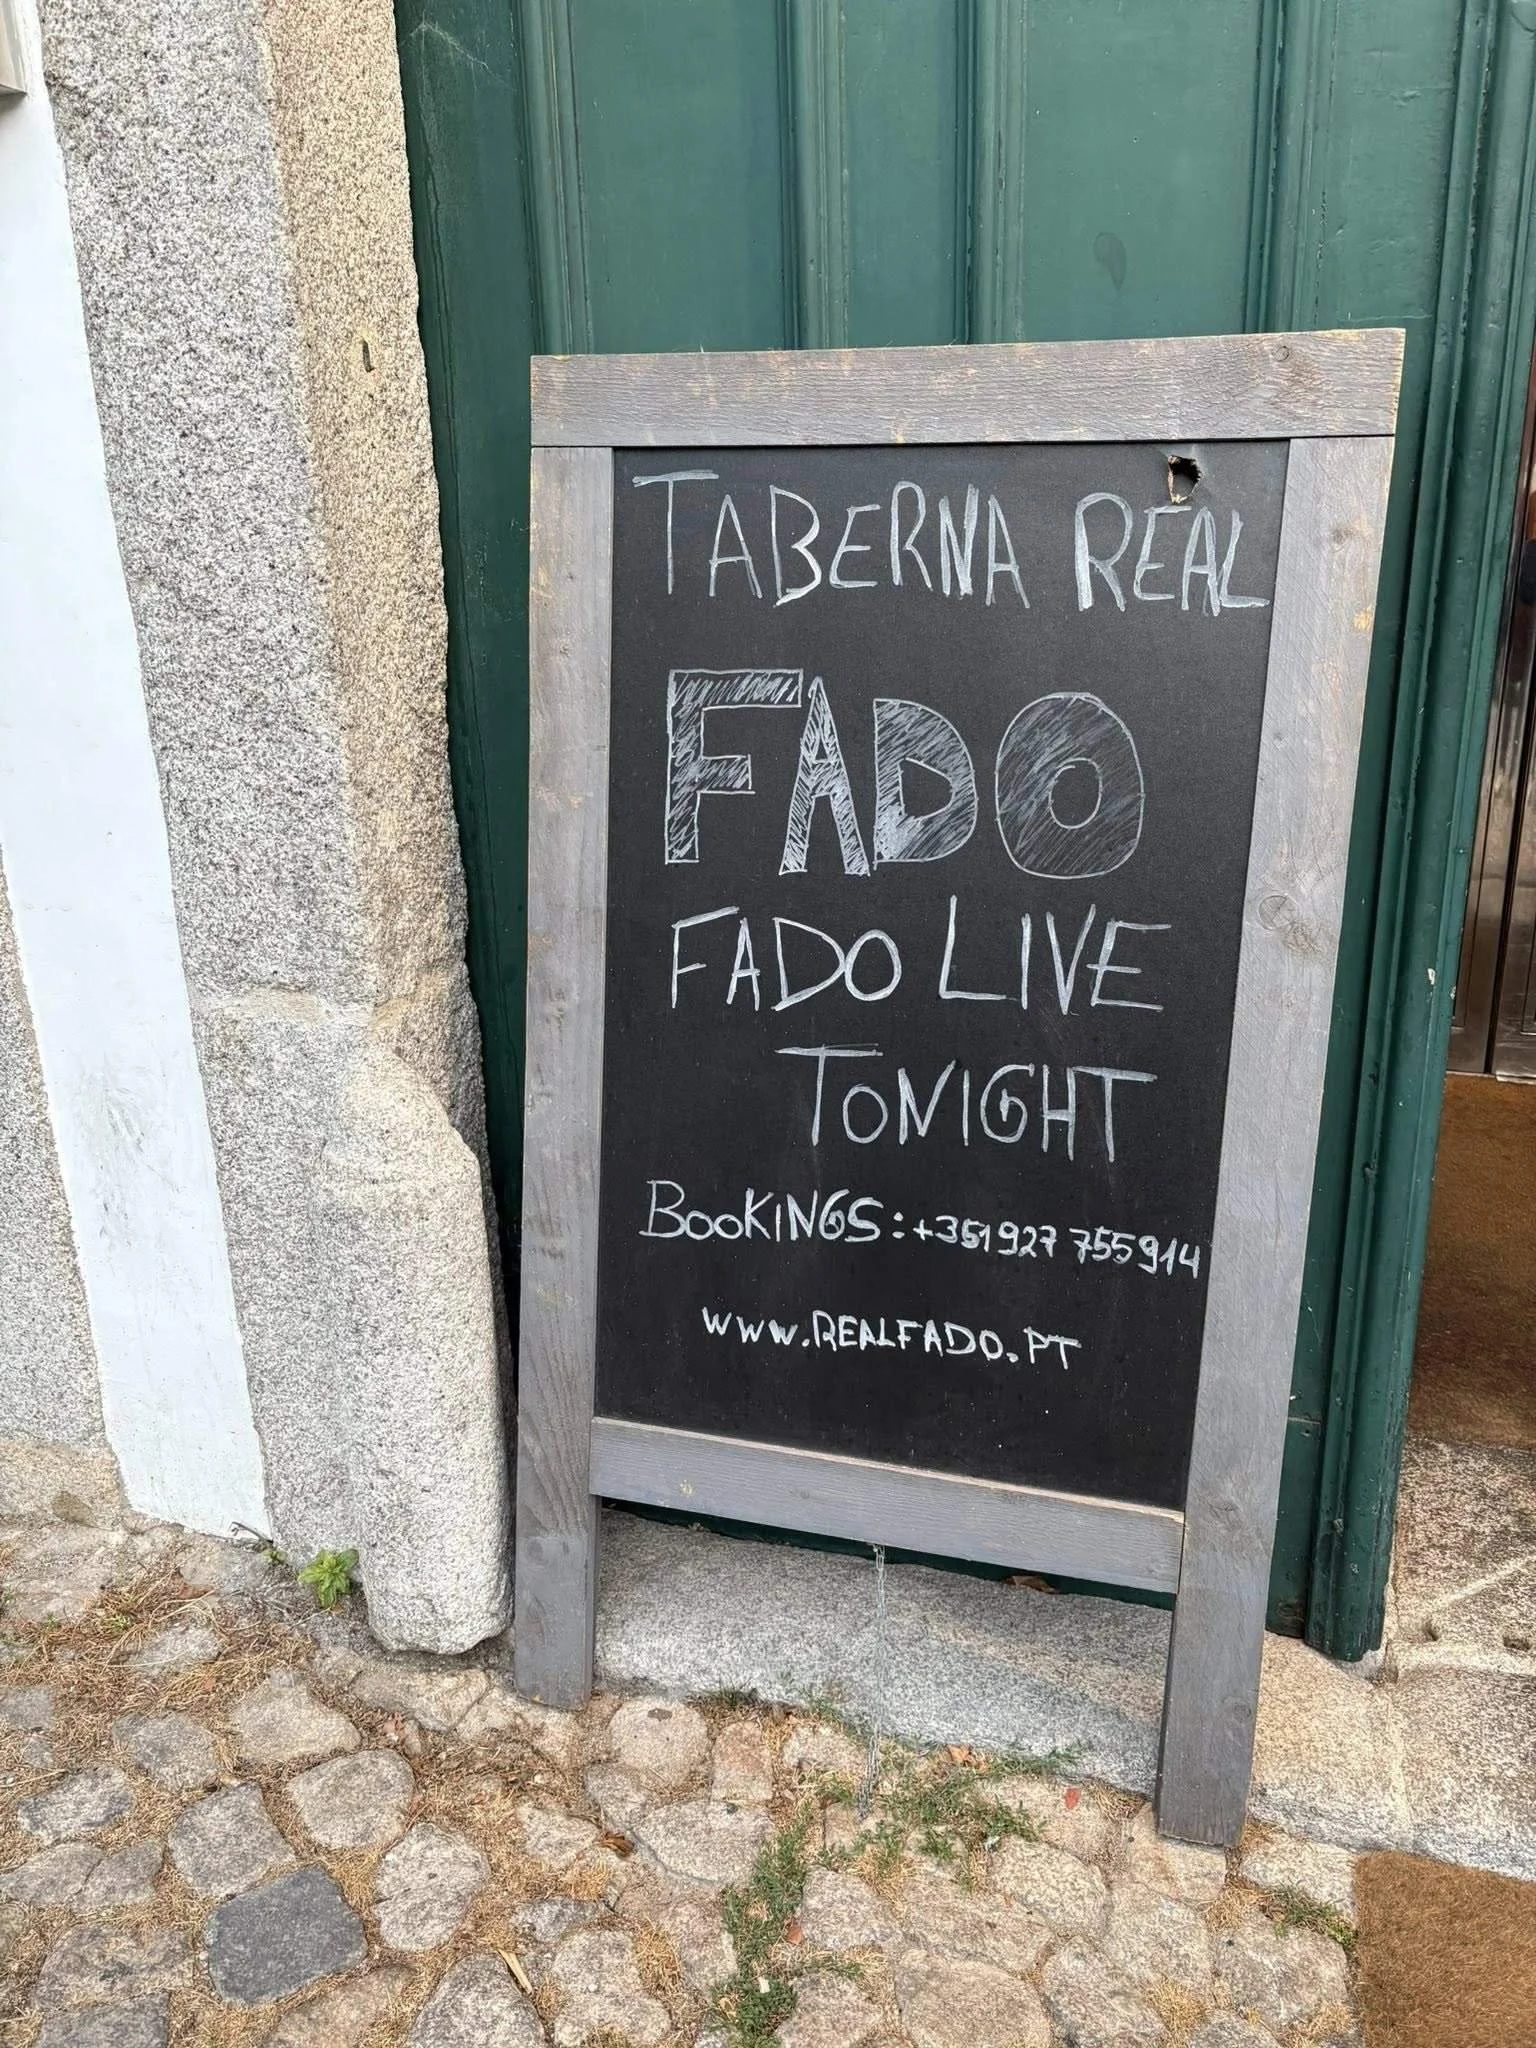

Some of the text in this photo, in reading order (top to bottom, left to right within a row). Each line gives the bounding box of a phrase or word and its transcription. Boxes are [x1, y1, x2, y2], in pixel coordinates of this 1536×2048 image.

[633, 469, 1271, 616] TABERNA REAL
[664, 668, 1146, 880] FADO
[671, 895, 1172, 1016] FADO LIVE
[774, 1043, 1158, 1163] TONIGHT
